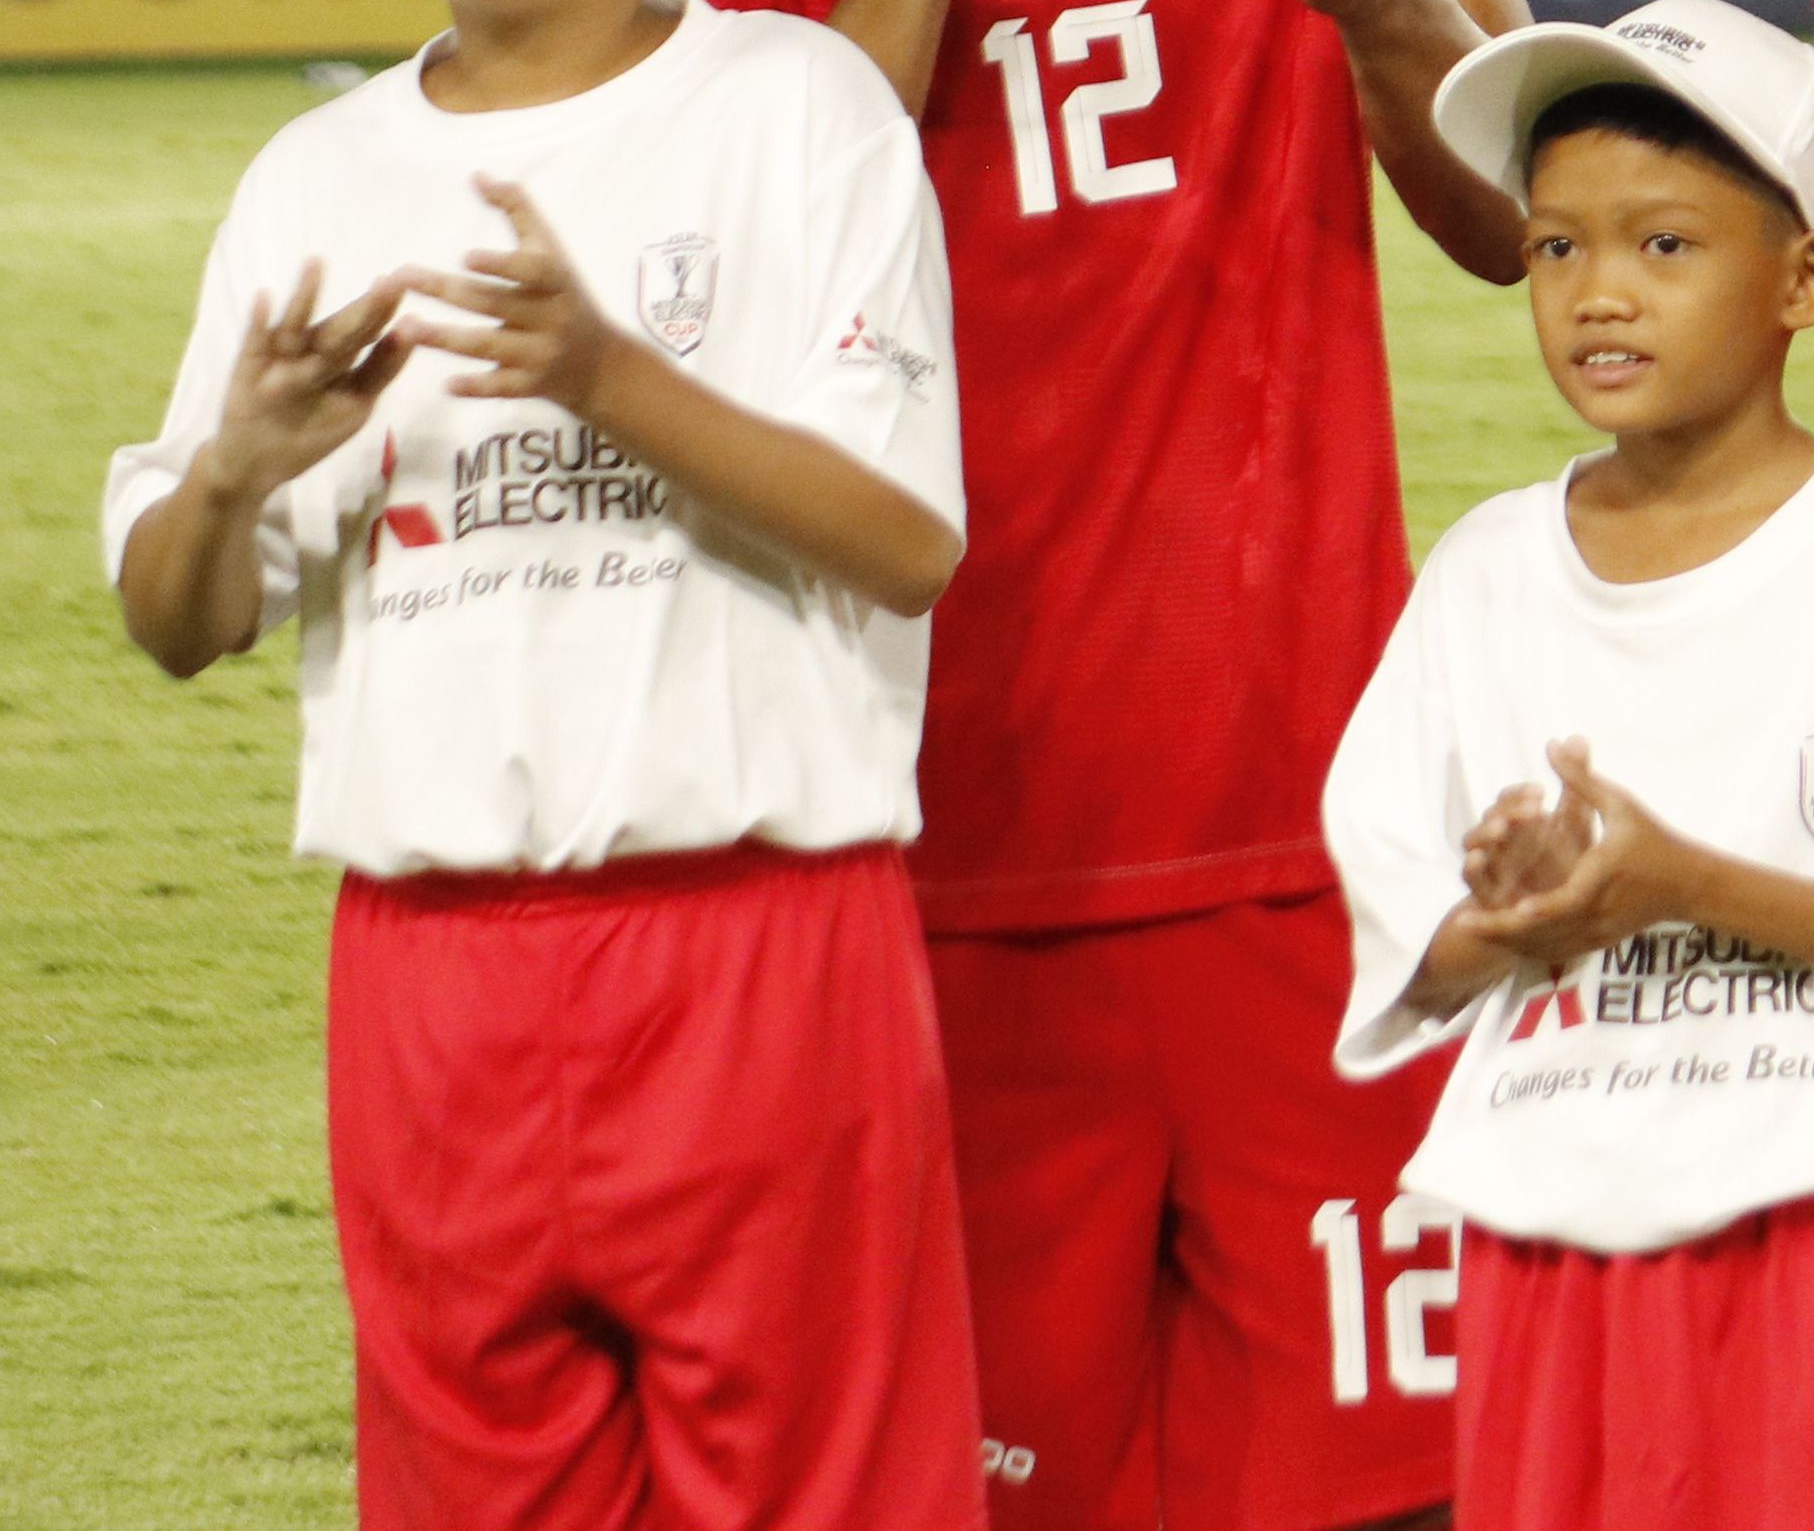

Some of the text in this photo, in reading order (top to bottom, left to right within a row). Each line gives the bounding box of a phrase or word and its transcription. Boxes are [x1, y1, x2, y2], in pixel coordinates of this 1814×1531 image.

[454, 474, 668, 542] ELECTRIC
[455, 564, 512, 607] for
[523, 558, 580, 590] the
[1606, 1060, 1660, 1096] for
[1670, 1054, 1730, 1086] the
[1309, 1194, 1465, 1406] 12
